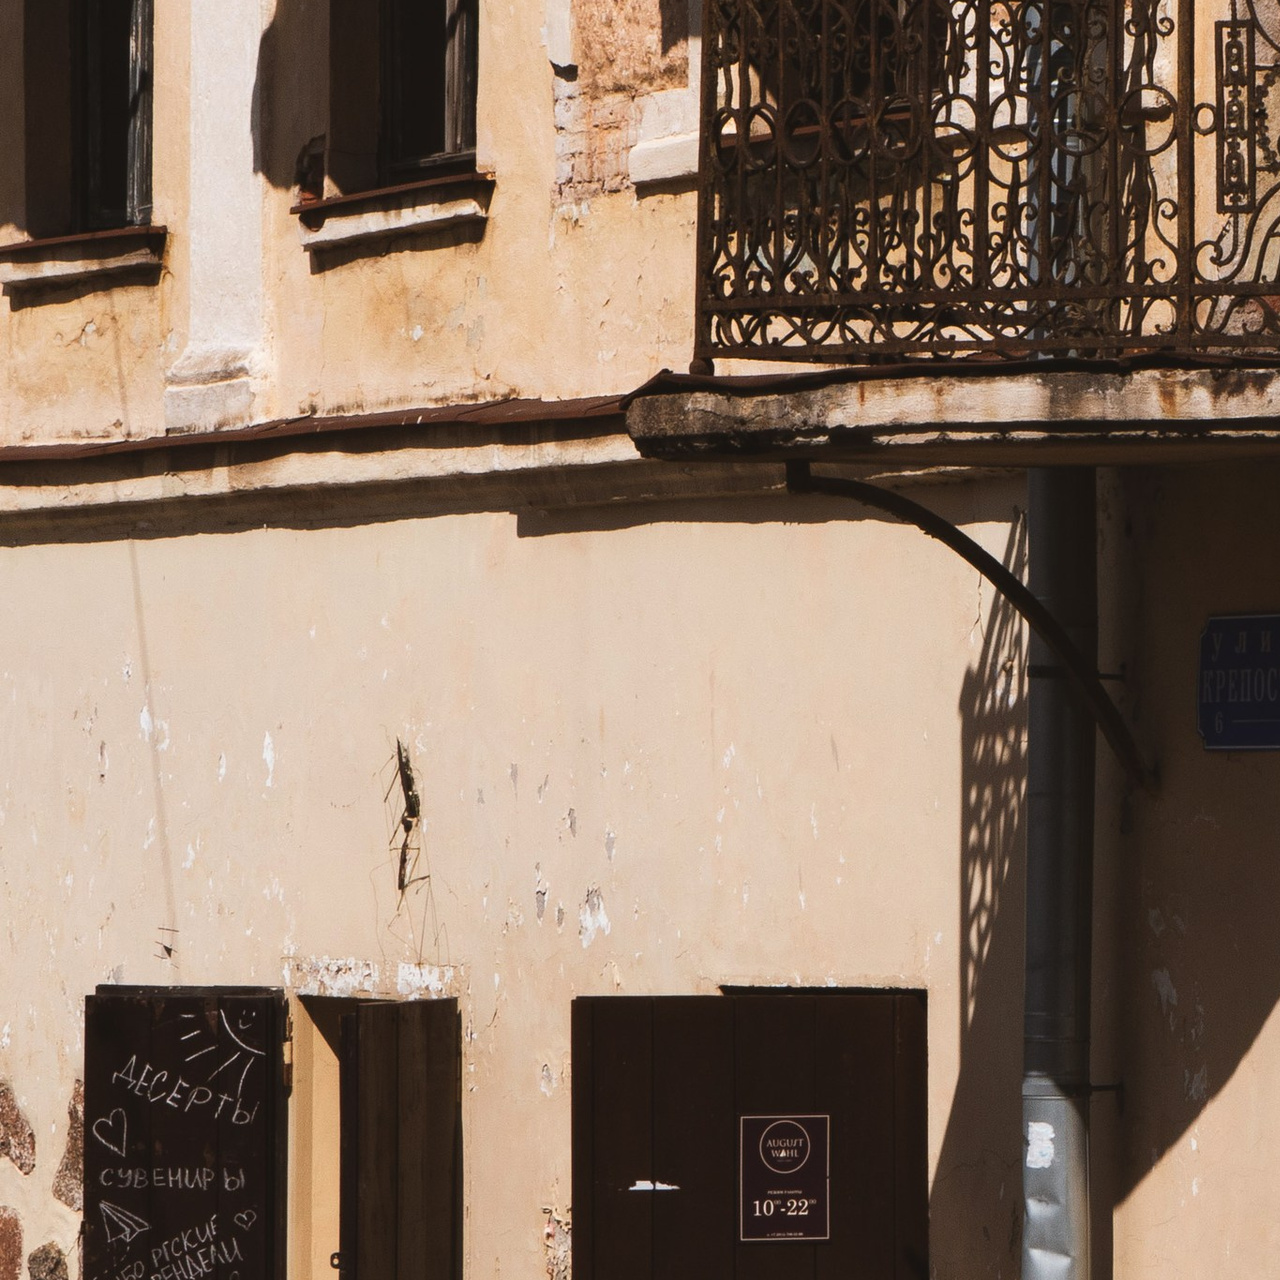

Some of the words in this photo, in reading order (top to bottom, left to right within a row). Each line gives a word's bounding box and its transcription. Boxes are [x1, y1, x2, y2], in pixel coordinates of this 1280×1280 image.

[1214, 710, 1224, 734] 6
[112, 1053, 260, 1125] ДЕСЕРТЫ
[766, 1138, 804, 1148] AUGUST
